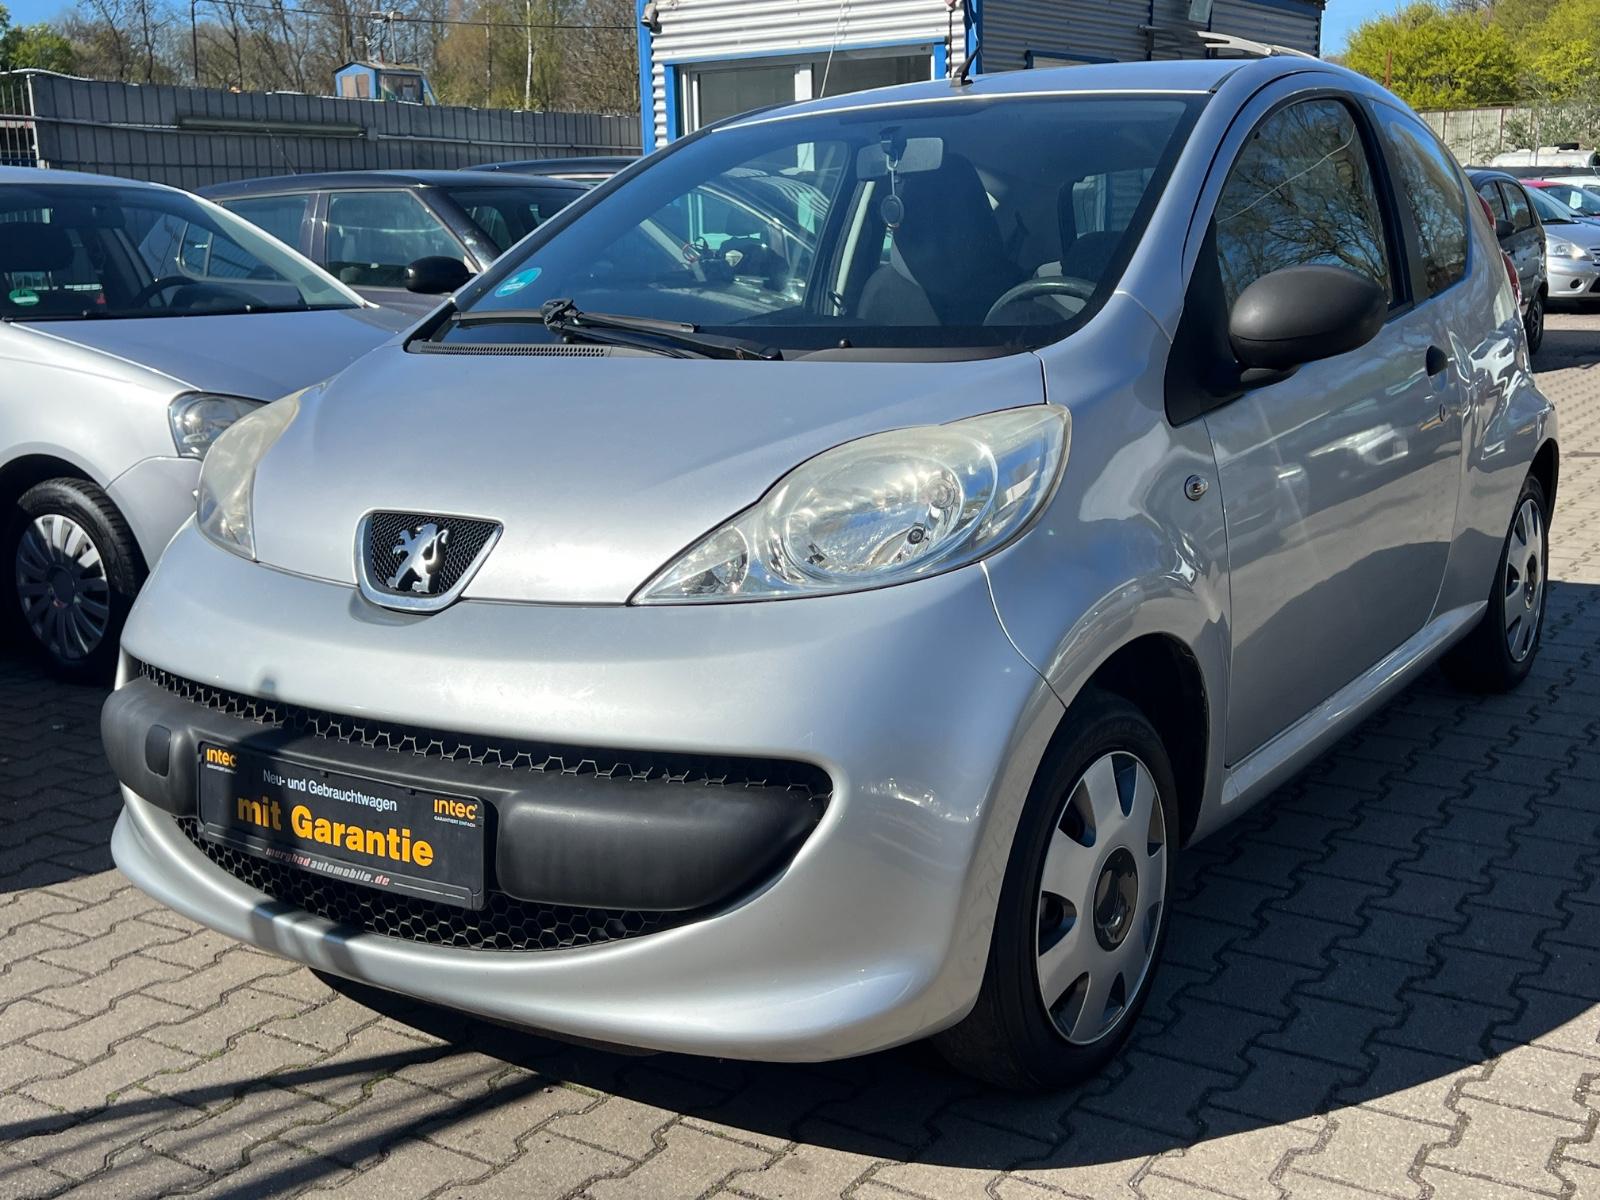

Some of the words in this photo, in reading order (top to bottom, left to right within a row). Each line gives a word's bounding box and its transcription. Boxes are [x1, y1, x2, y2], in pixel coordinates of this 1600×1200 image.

[263, 769, 285, 786] Neu-
[287, 777, 306, 792] und
[308, 780, 397, 812] Gebrauchtwagen
[237, 796, 281, 832] mit
[291, 804, 433, 867] Garantie
